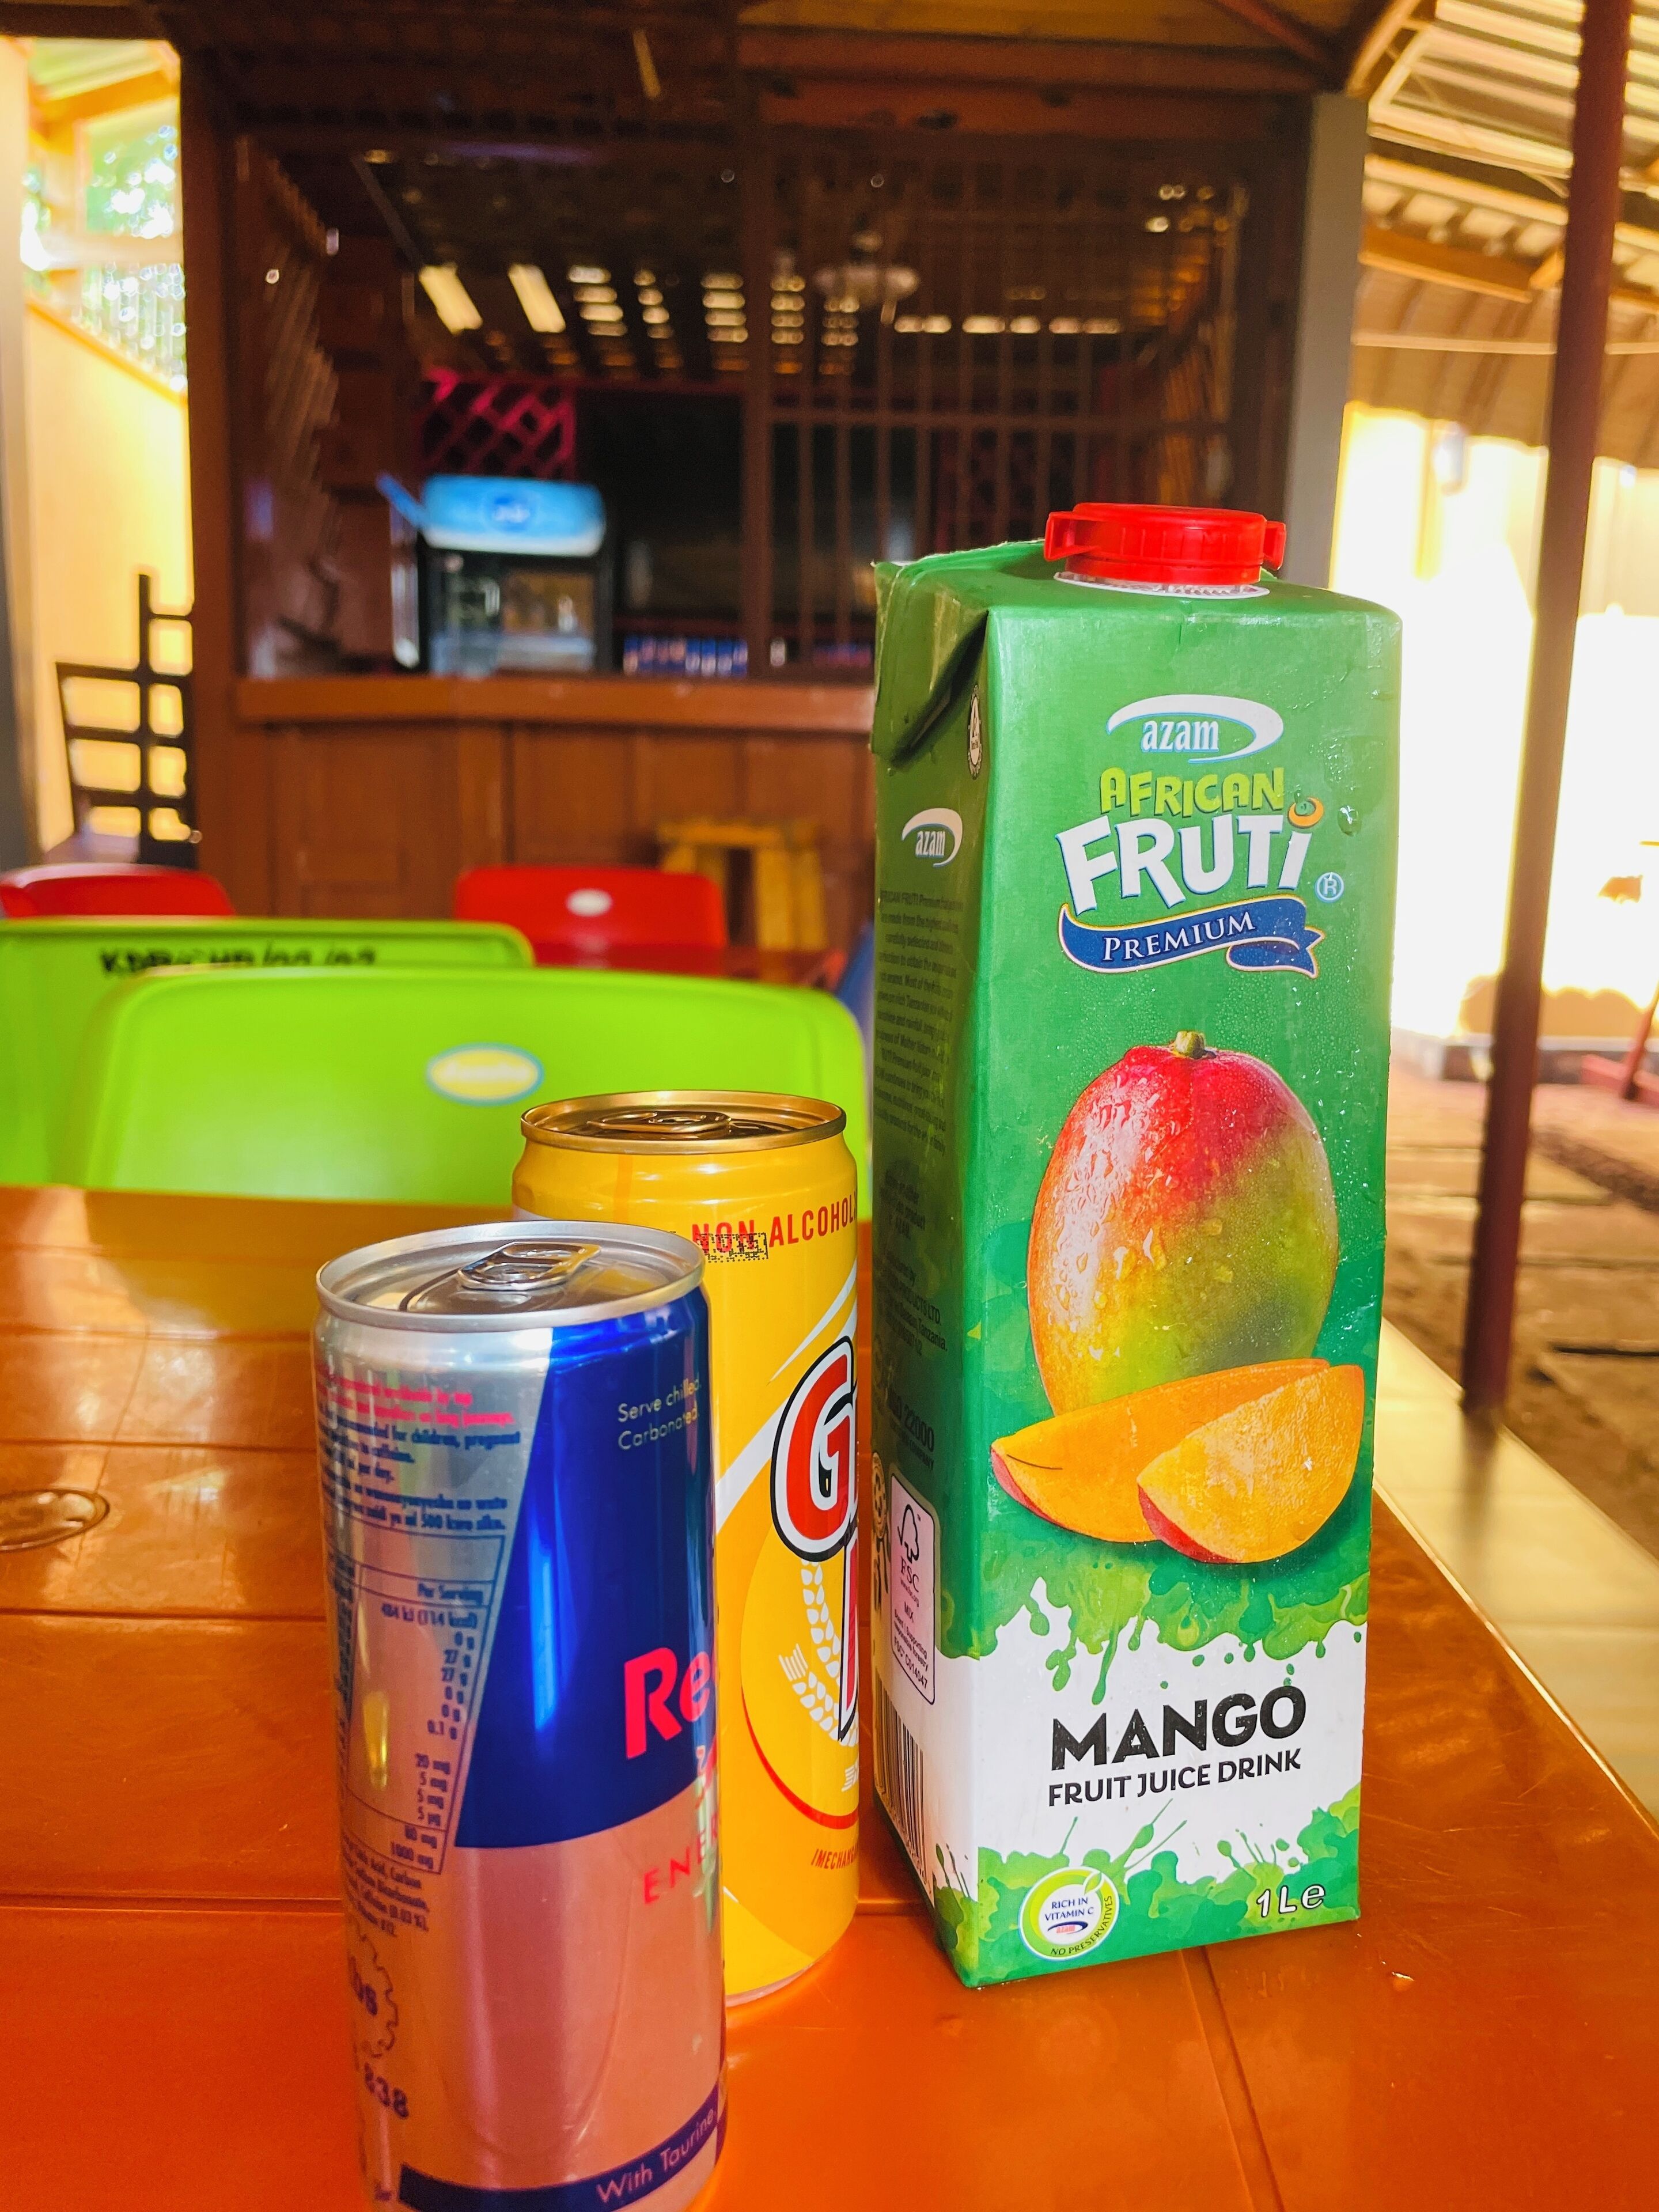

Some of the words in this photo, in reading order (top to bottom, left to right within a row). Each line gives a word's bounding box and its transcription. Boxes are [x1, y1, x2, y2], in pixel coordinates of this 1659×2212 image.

[1141, 719, 1219, 752] azam
[1099, 766, 1285, 819] AFRICAN
[915, 830, 946, 858] azam
[1101, 911, 1256, 963] PREMIUM
[692, 1219, 755, 1255] NON
[918, 1317, 948, 1351] Tanzania.
[618, 1399, 662, 1423] Serve
[901, 1555, 919, 1593] FSC
[624, 1647, 714, 1760] Re
[1051, 1685, 1307, 1771] MANGO
[1048, 1775, 1132, 1807] FRUIT
[1137, 1763, 1211, 1798] JUICE
[1218, 1748, 1302, 1783] DRINK
[1044, 1908, 1085, 1921] VITAMIN
[1088, 1906, 1094, 1915] C
[1052, 1899, 1075, 1910] RICH
[1078, 1896, 1089, 1906] IN
[1051, 1947, 1066, 1956] NO
[1069, 1895, 1113, 1955] PRESERVATIVES
[596, 2162, 653, 2203] With
[660, 2108, 714, 2172] Taurine
